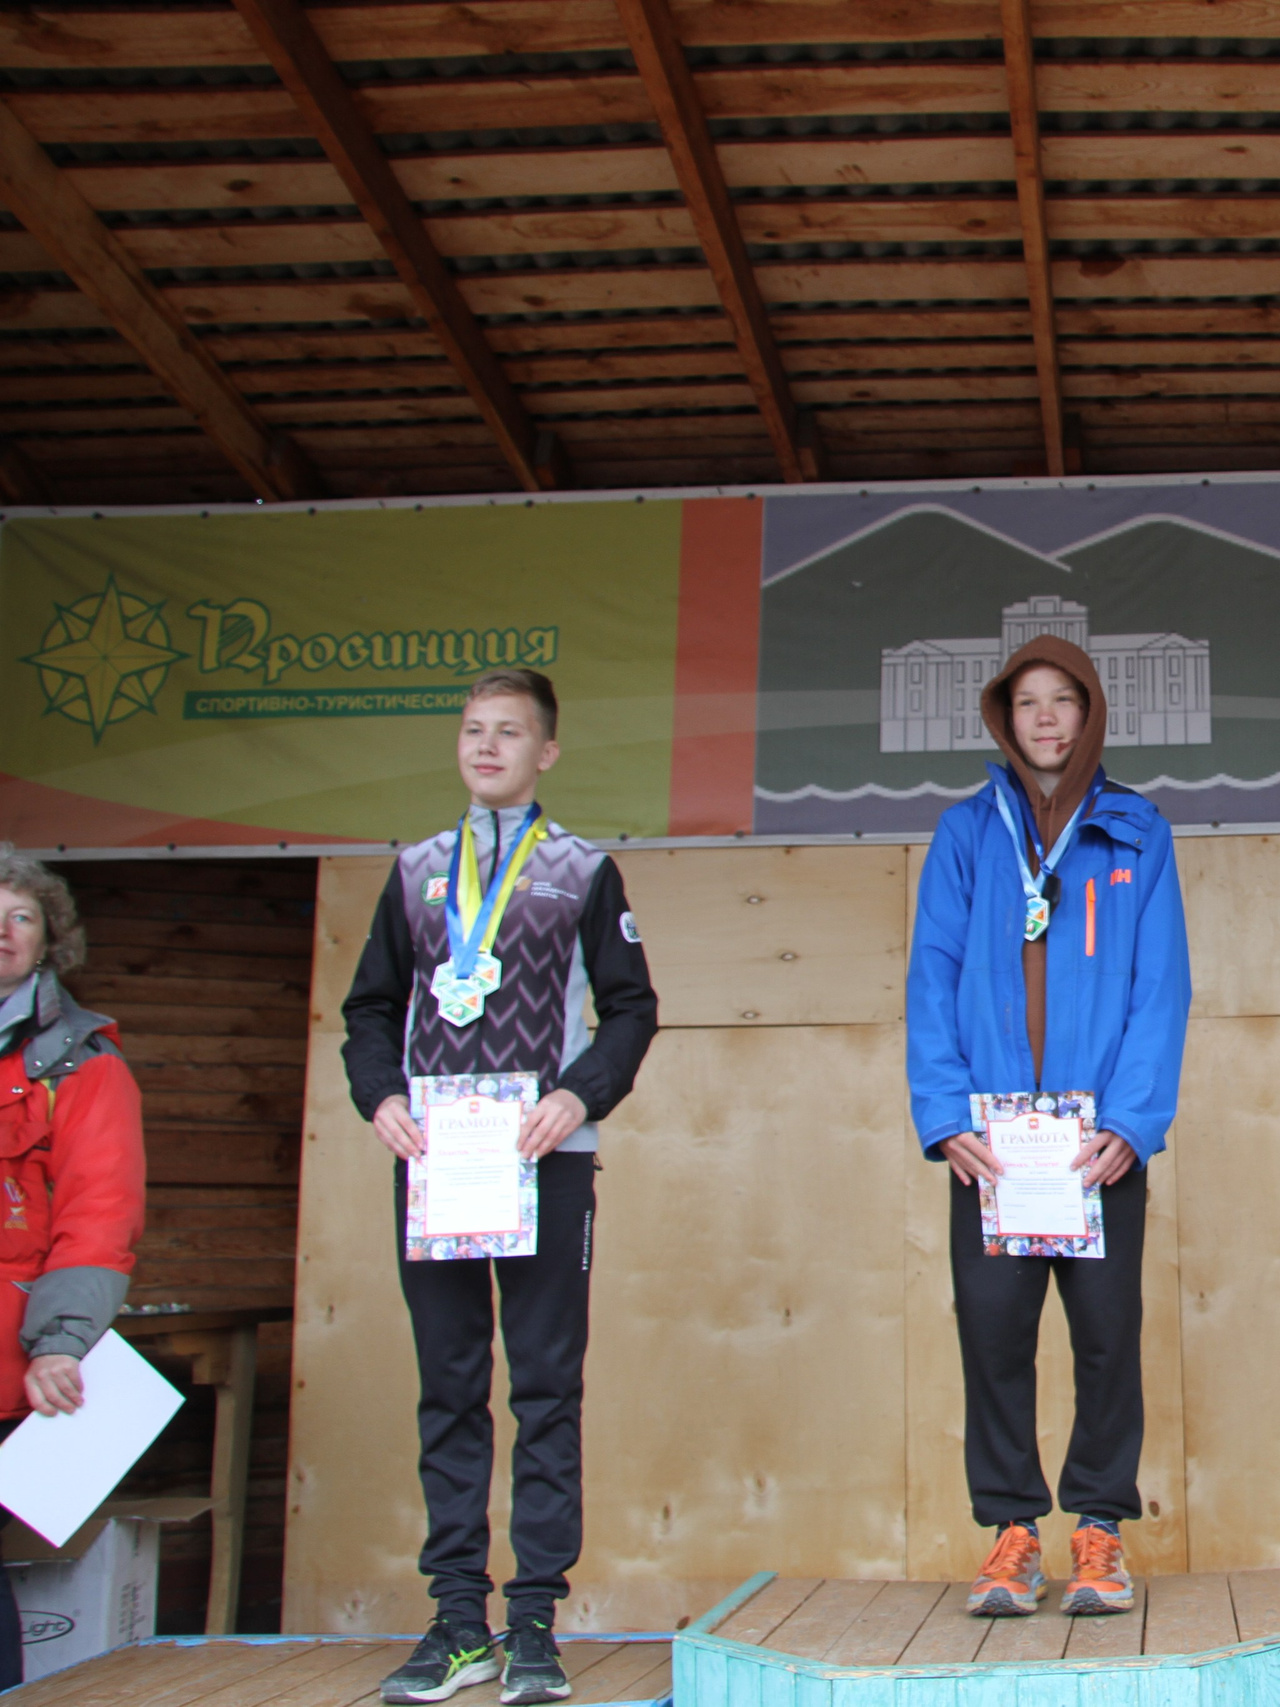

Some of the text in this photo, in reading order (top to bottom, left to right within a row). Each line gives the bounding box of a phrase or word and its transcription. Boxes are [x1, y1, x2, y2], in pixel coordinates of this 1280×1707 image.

[186, 598, 559, 684] Провинция
[438, 1116, 509, 1130] ГРАМОТА
[1000, 1132, 1070, 1145] ГРАМОТА
[22, 1620, 66, 1636] ight
